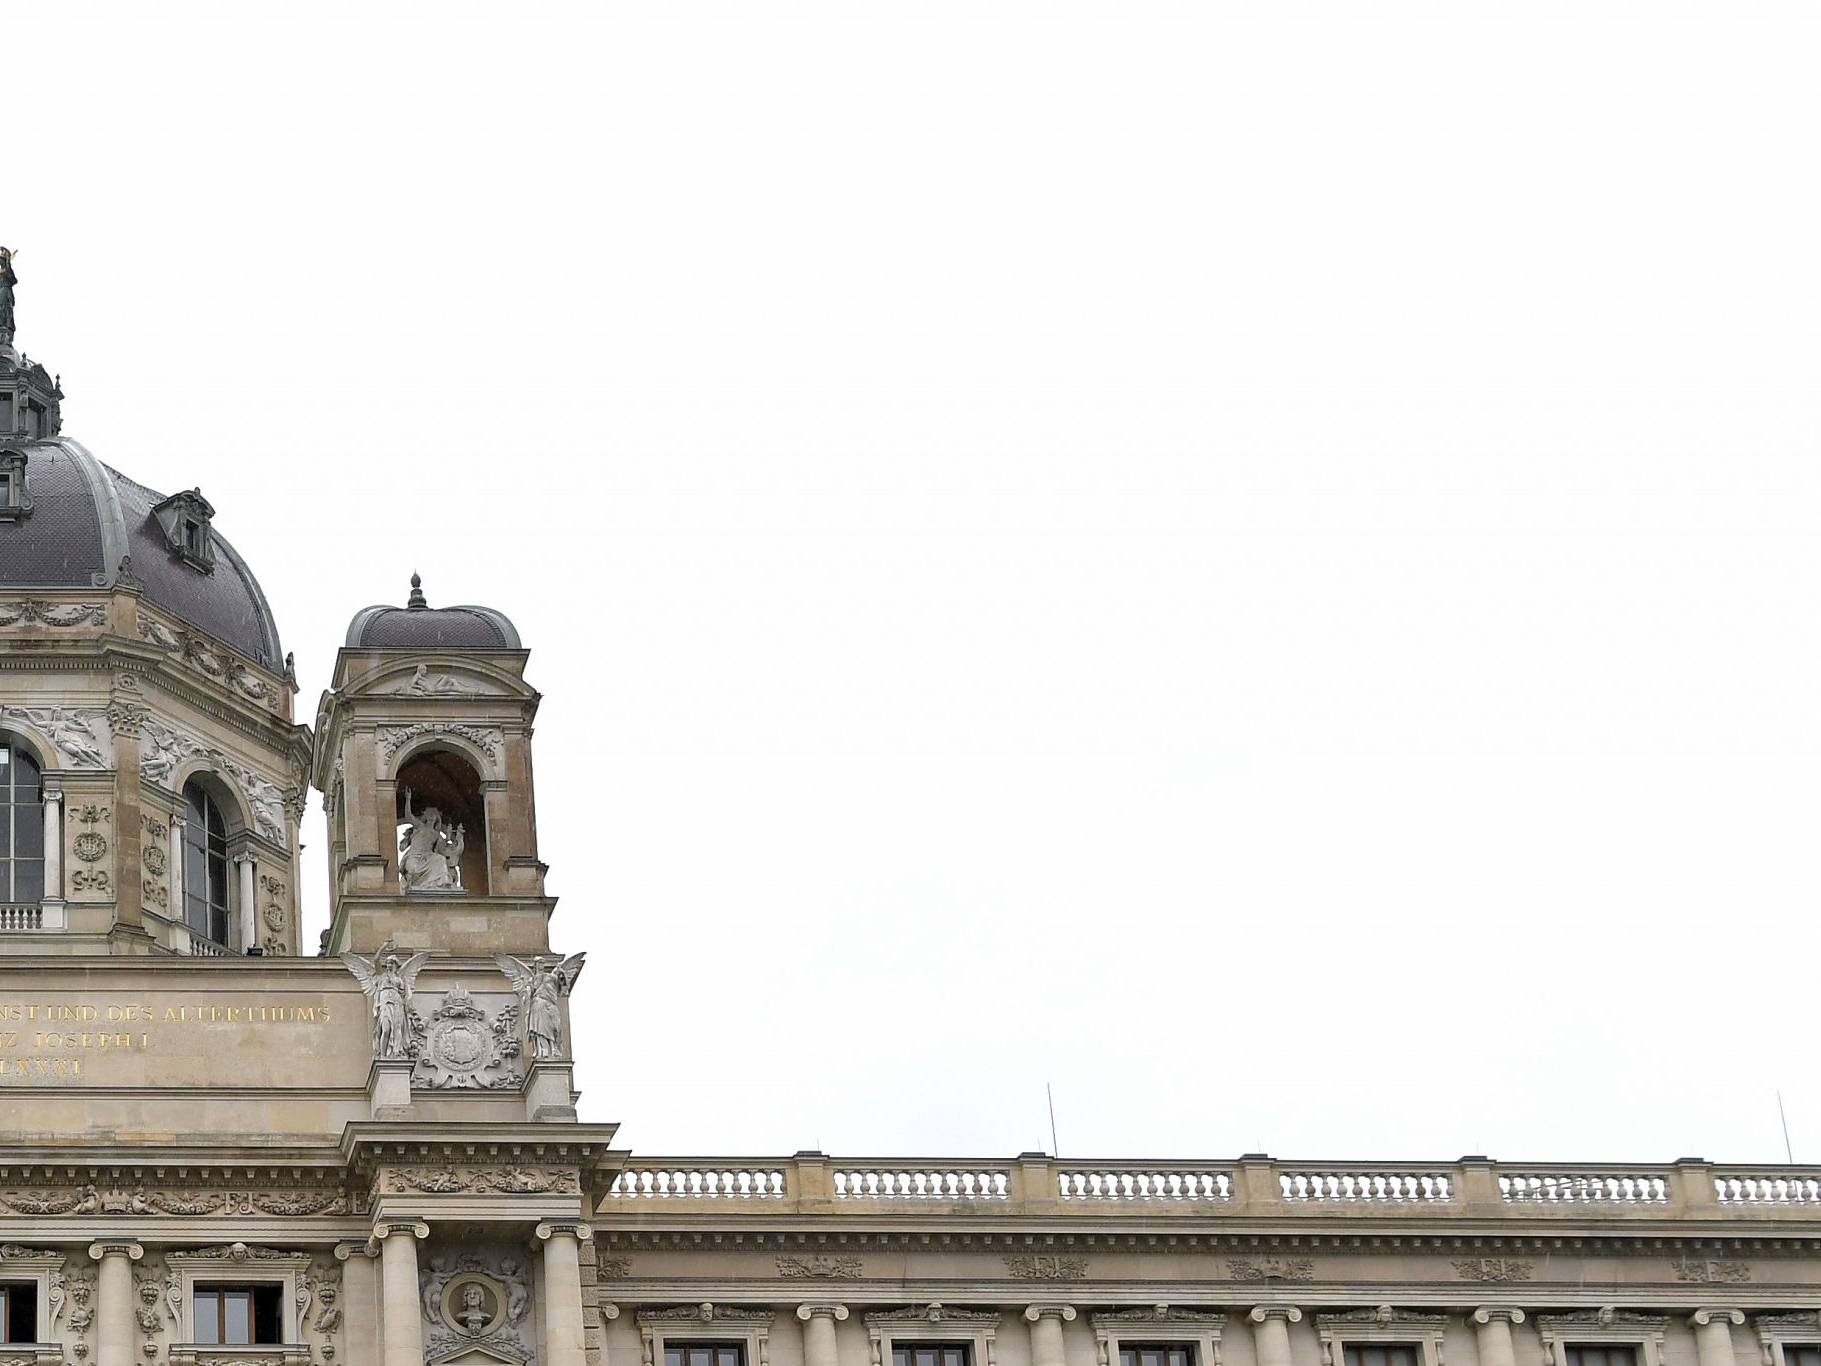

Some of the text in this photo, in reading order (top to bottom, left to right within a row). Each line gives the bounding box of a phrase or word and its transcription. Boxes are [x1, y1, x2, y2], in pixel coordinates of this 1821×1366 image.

[46, 1004, 98, 1022] UND
[107, 1005, 154, 1022] DES
[163, 1005, 331, 1023] ALTERTHUMS
[34, 1031, 131, 1049] JOSEPH
